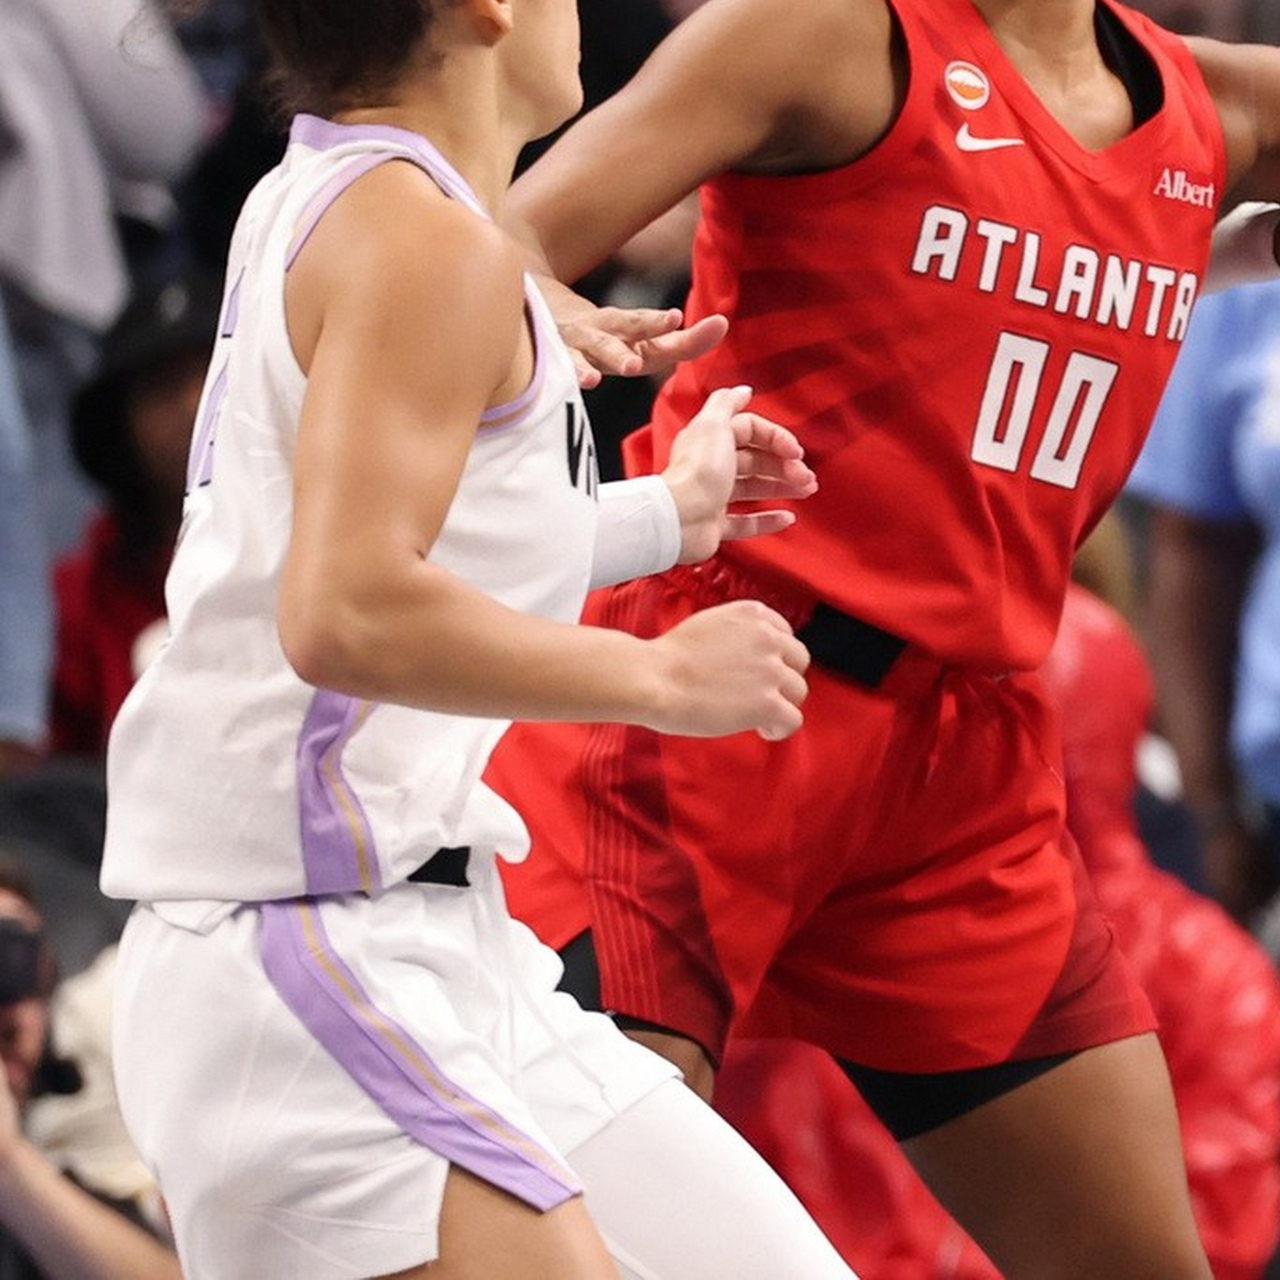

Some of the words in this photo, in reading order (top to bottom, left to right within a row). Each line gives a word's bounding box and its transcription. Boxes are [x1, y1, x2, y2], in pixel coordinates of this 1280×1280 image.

[1153, 167, 1215, 209] Albert
[910, 202, 1198, 342] ATLANTA
[969, 329, 1121, 491] 00
